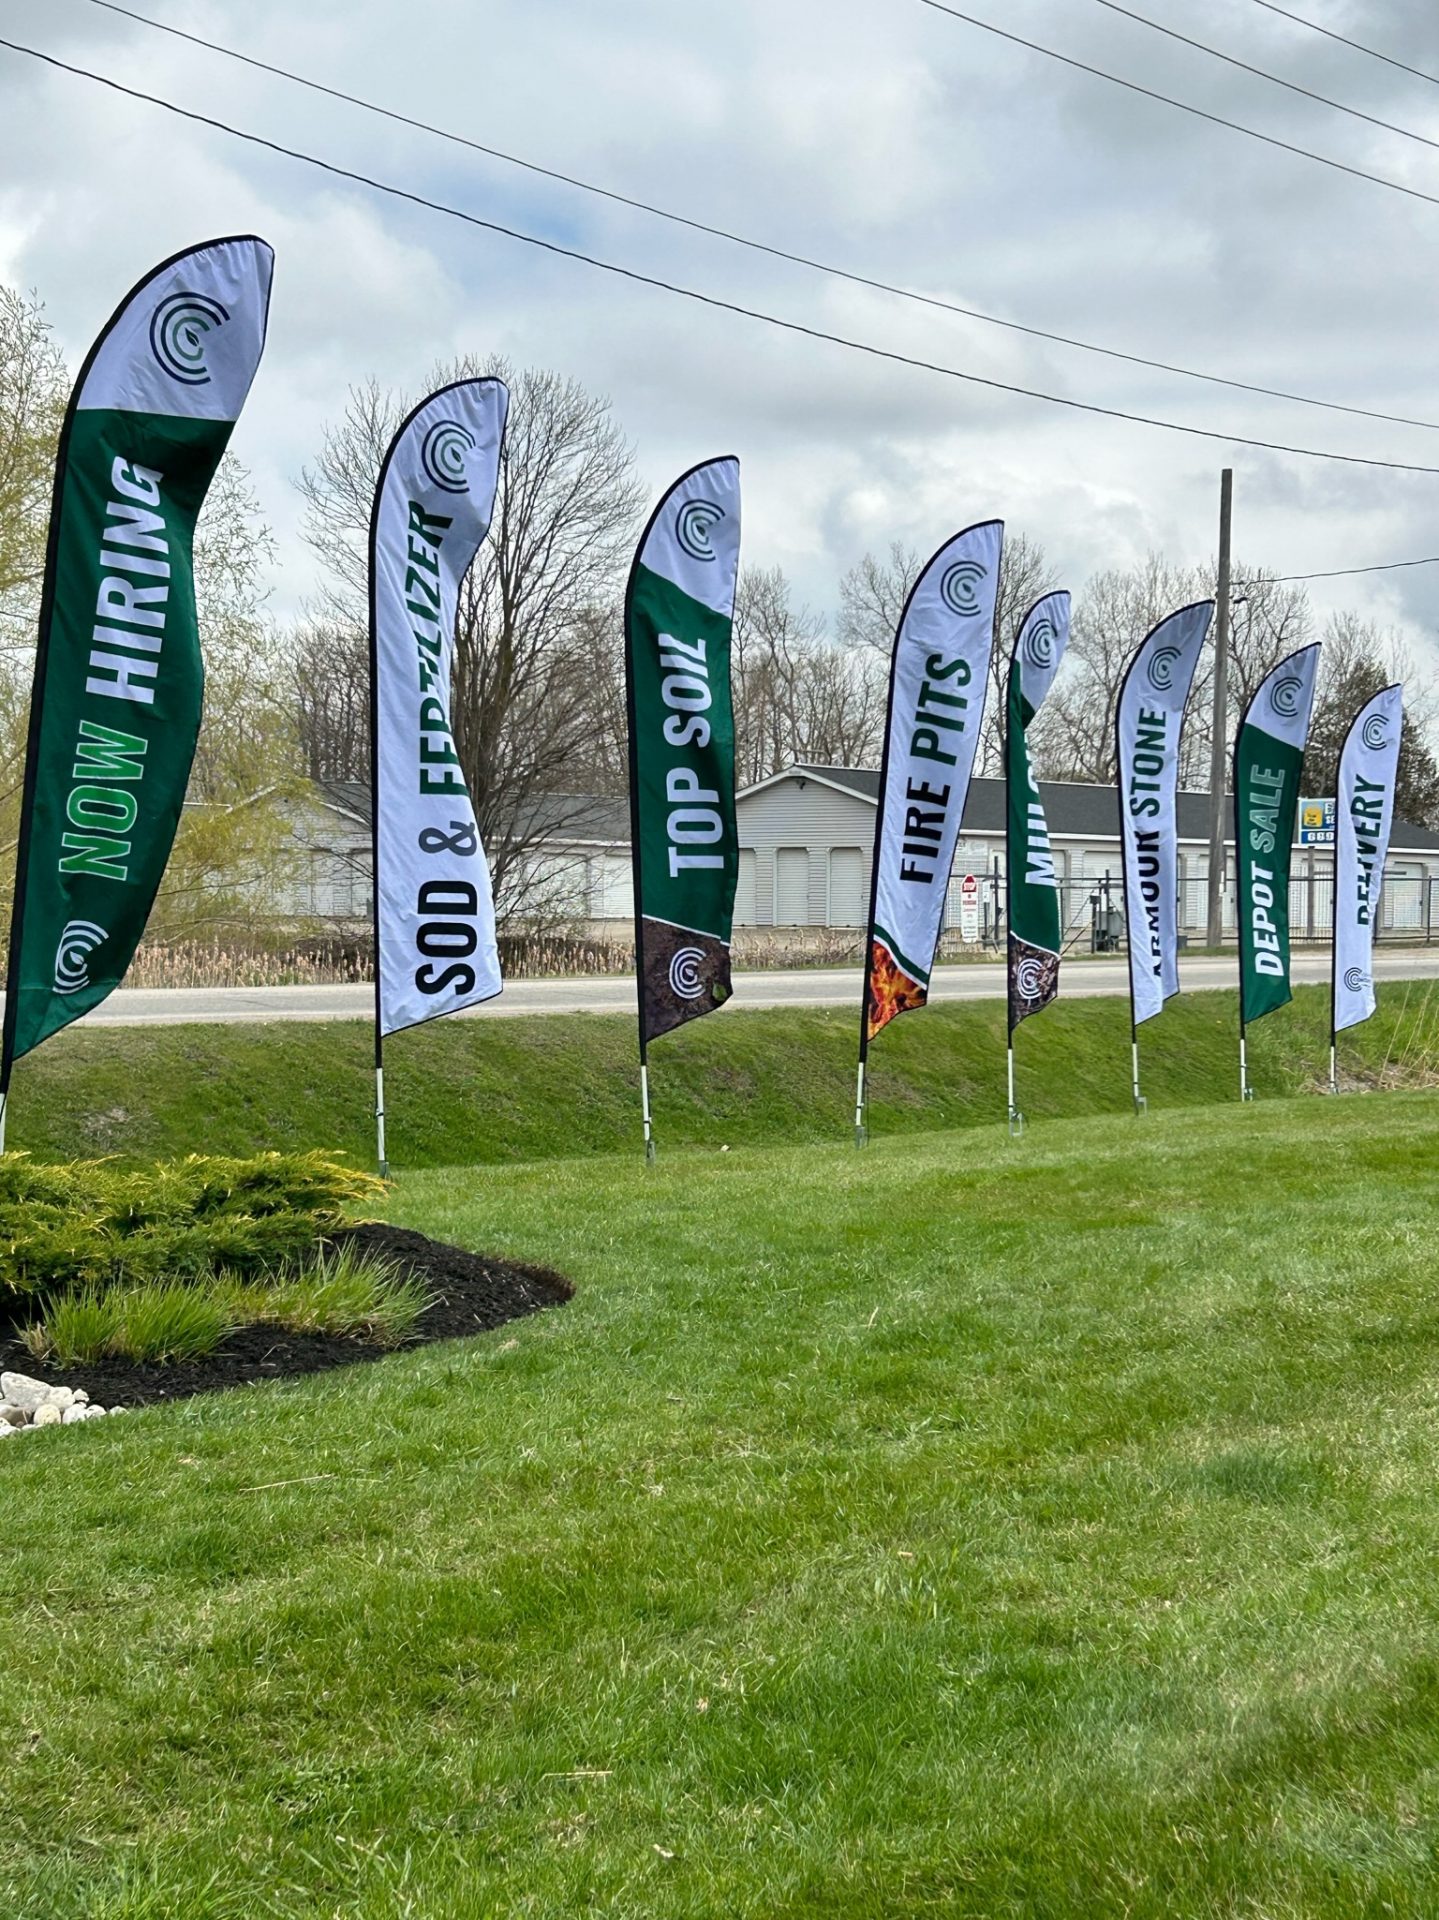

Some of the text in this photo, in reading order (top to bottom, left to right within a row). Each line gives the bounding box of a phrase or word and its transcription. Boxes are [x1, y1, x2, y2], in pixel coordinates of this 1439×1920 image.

[59, 456, 171, 882] NOW HIRING
[658, 632, 724, 878] TOP SOIL
[900, 653, 973, 884] FIRE PITS
[1129, 705, 1167, 818] STONE
[415, 880, 478, 996] SOD
[418, 821, 478, 856] &
[1249, 764, 1286, 977] DEPOT SALE
